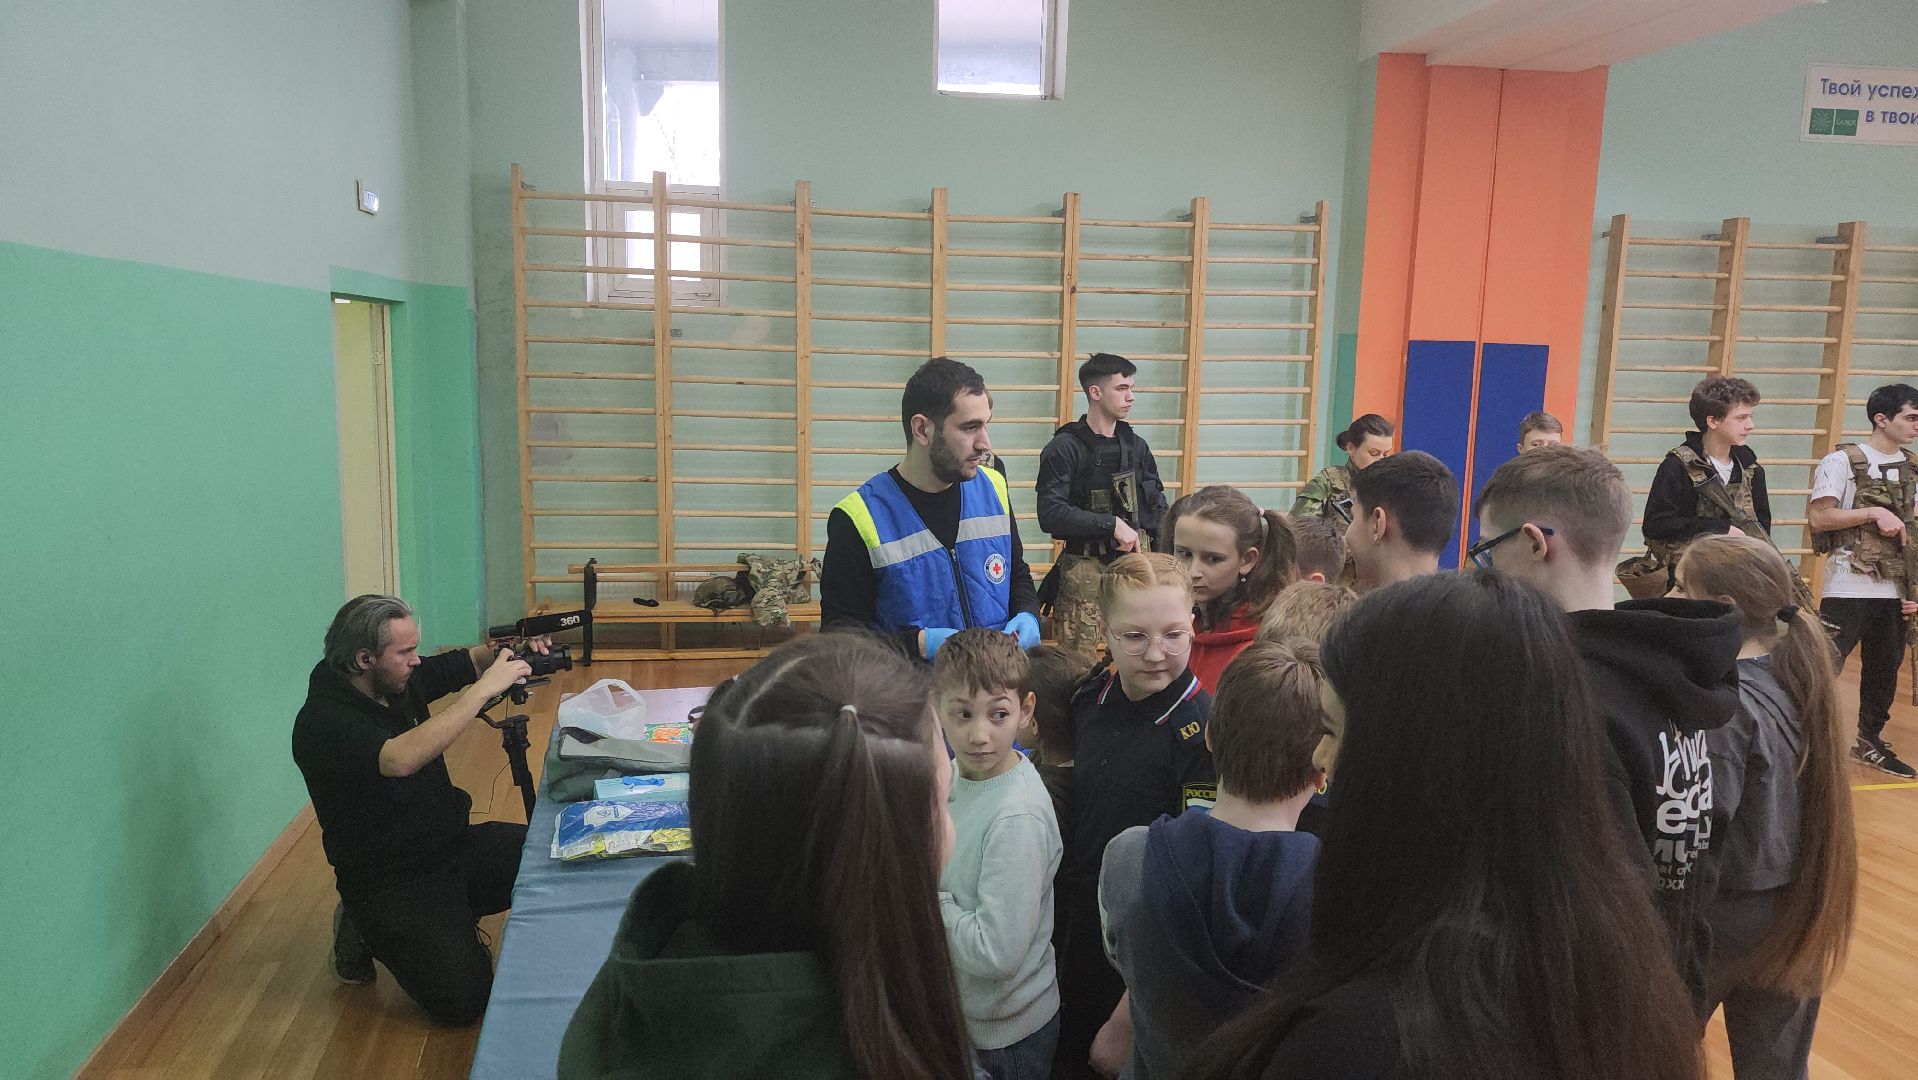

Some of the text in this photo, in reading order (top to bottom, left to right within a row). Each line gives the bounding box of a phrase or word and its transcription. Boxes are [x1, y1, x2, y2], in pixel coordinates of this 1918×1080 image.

[1820, 78, 1861, 96] Твой
[1865, 110, 1874, 123] в
[560, 615, 580, 627] 360
[1179, 721, 1201, 740] КЮ
[1185, 788, 1216, 799] РОССИ
